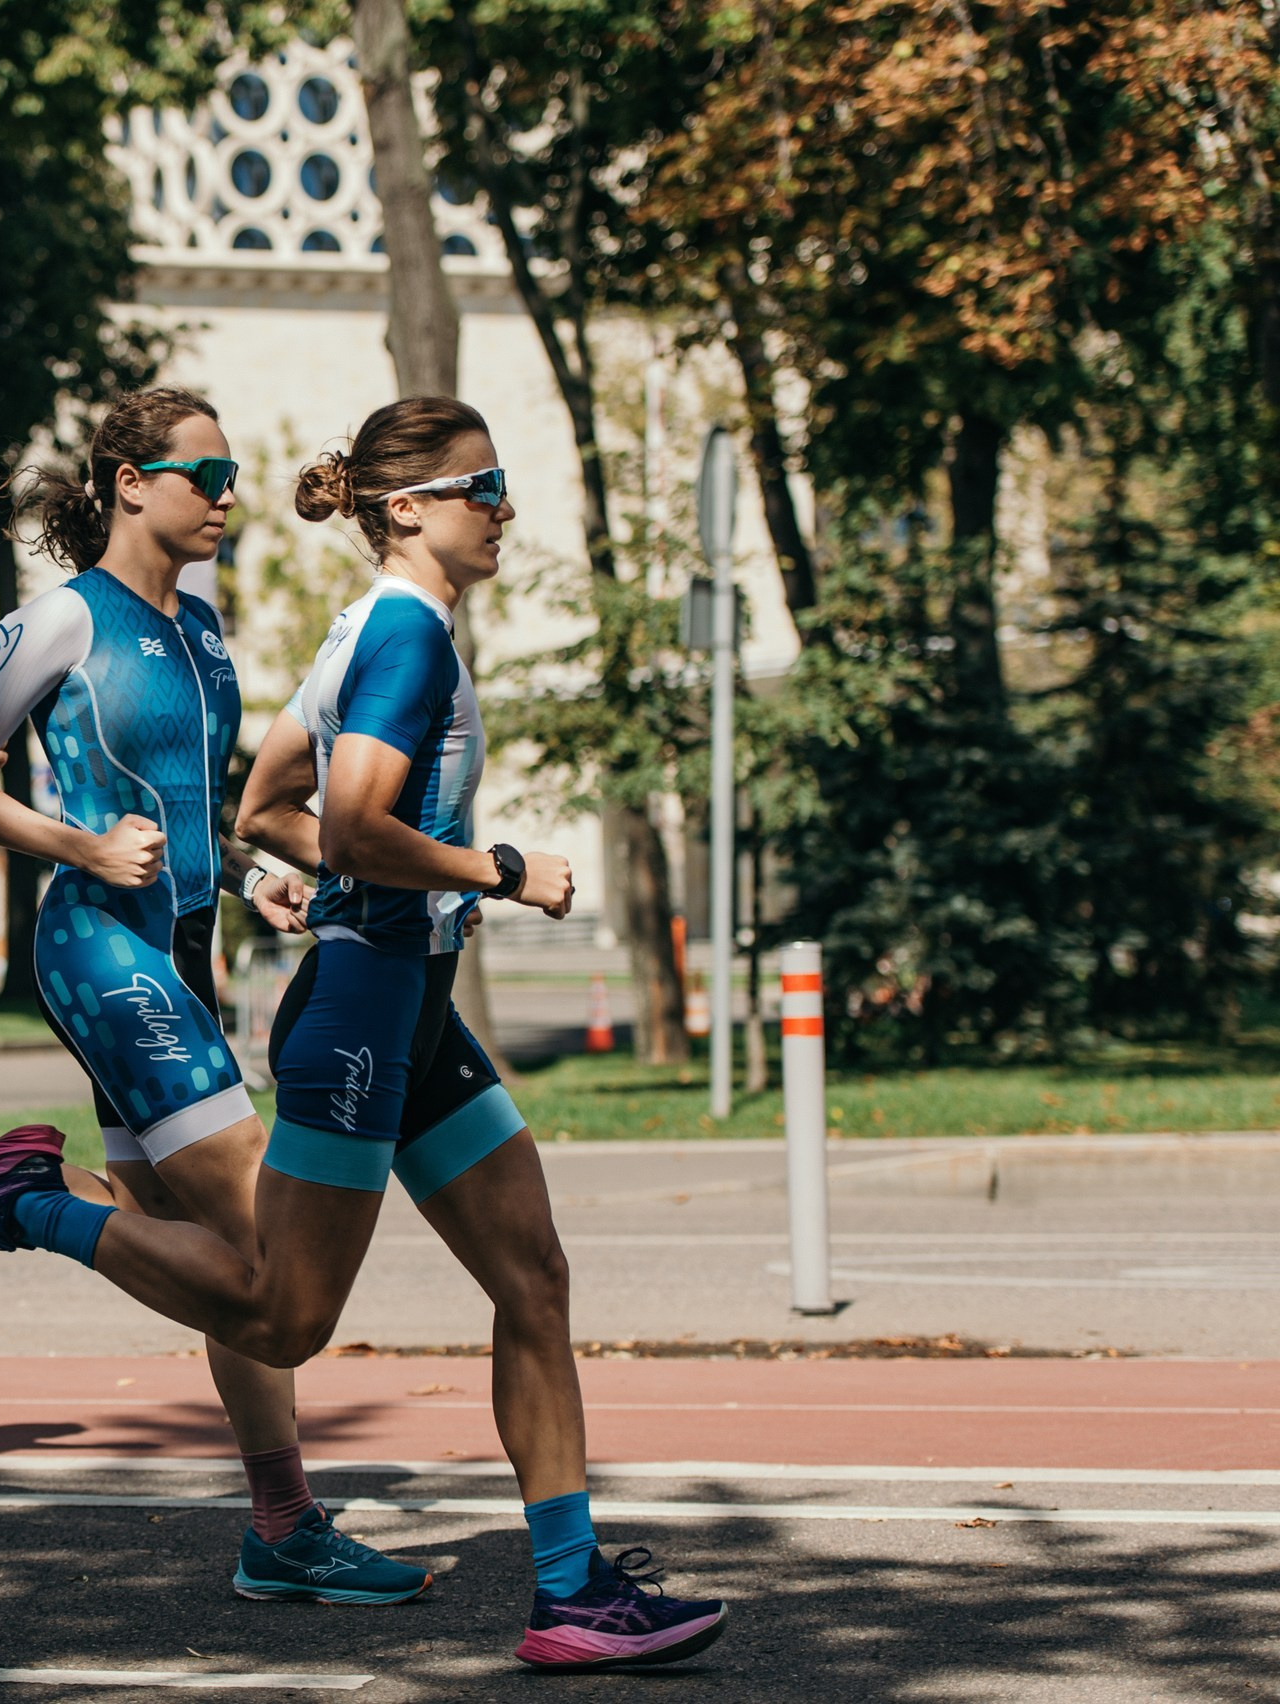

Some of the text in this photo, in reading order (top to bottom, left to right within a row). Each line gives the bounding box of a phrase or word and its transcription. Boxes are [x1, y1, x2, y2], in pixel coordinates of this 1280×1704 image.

[210, 667, 237, 690] Tril
[101, 972, 192, 1063] Trilogy
[329, 1046, 373, 1132] Trilogy
